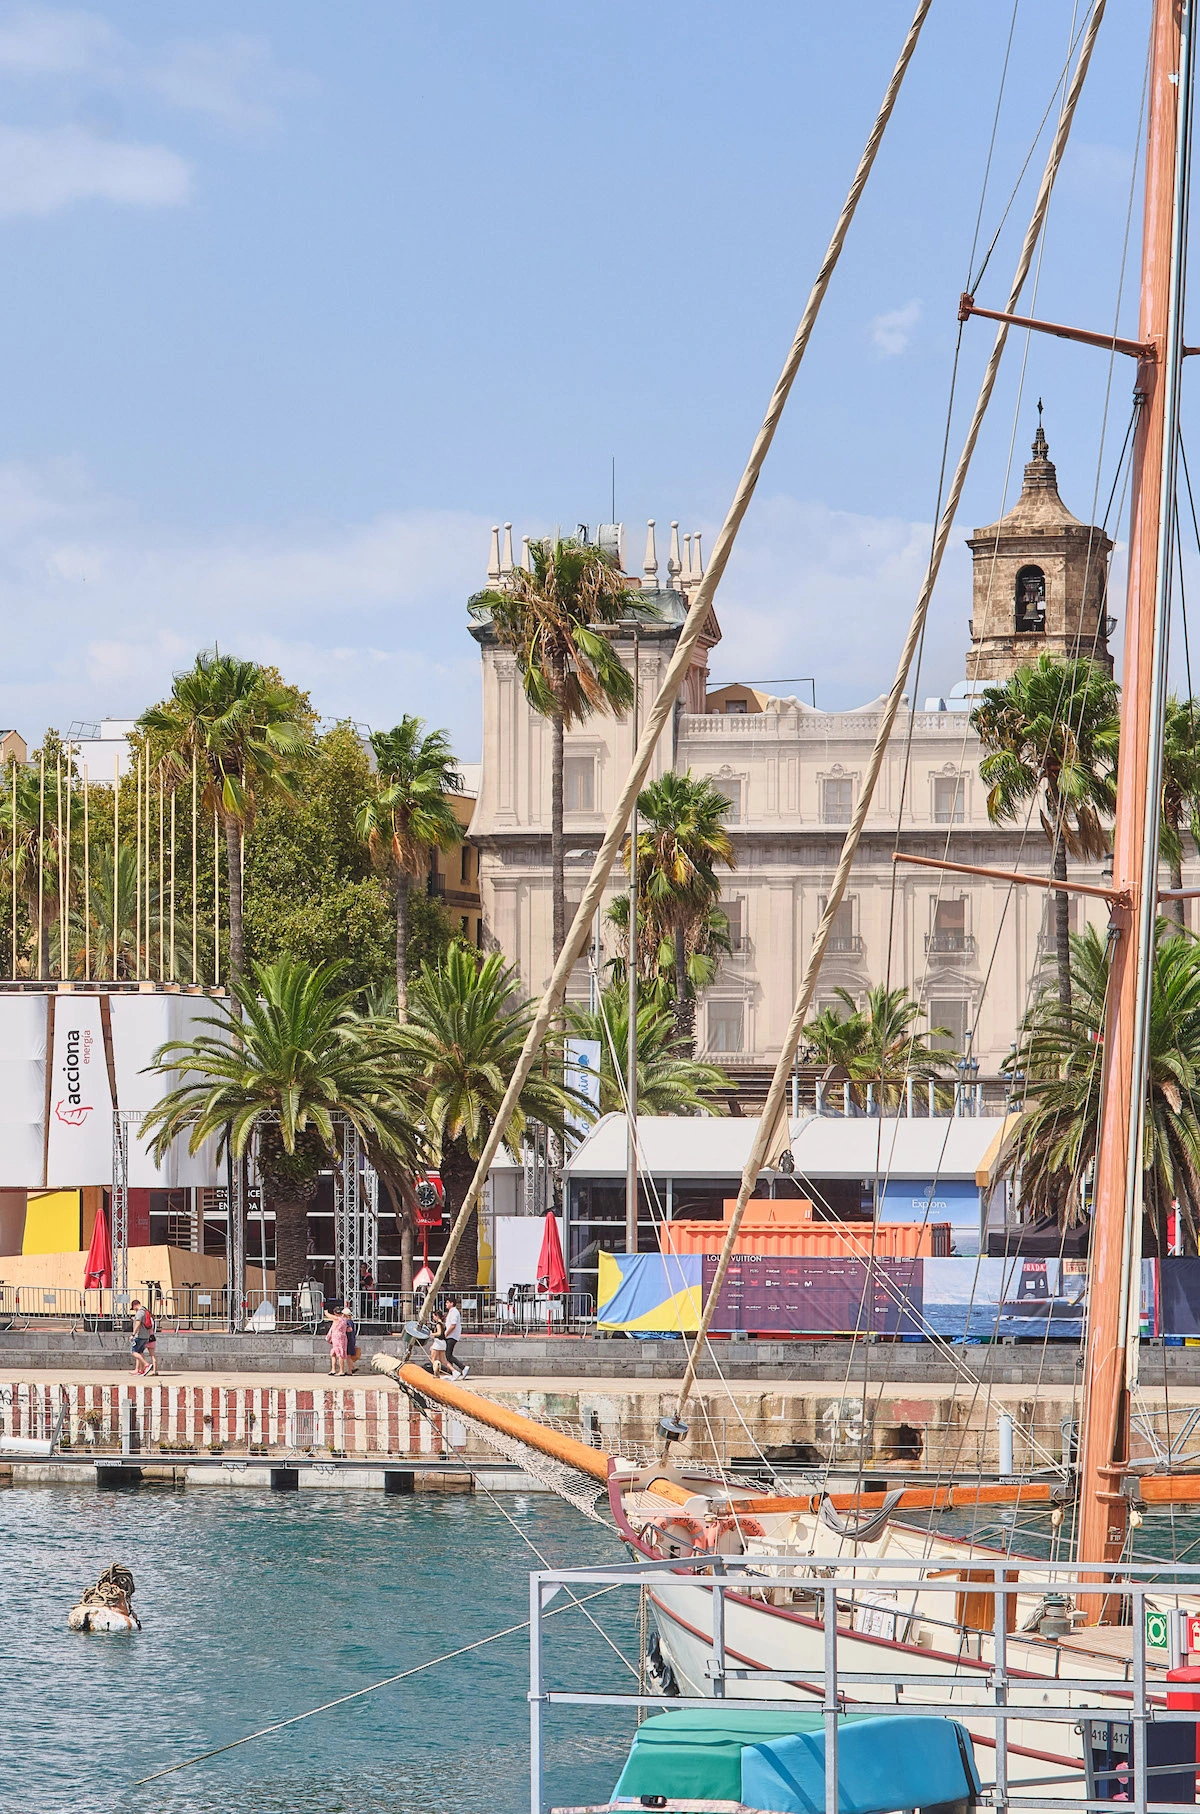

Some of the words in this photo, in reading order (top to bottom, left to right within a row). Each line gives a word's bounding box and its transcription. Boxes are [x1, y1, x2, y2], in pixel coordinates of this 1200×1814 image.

[82, 1029, 93, 1065] energía
[63, 1030, 81, 1105] acciona
[1023, 1263, 1046, 1272] PRADA
[1091, 1729, 1108, 1742] 418
[1112, 1732, 1130, 1745] 417
